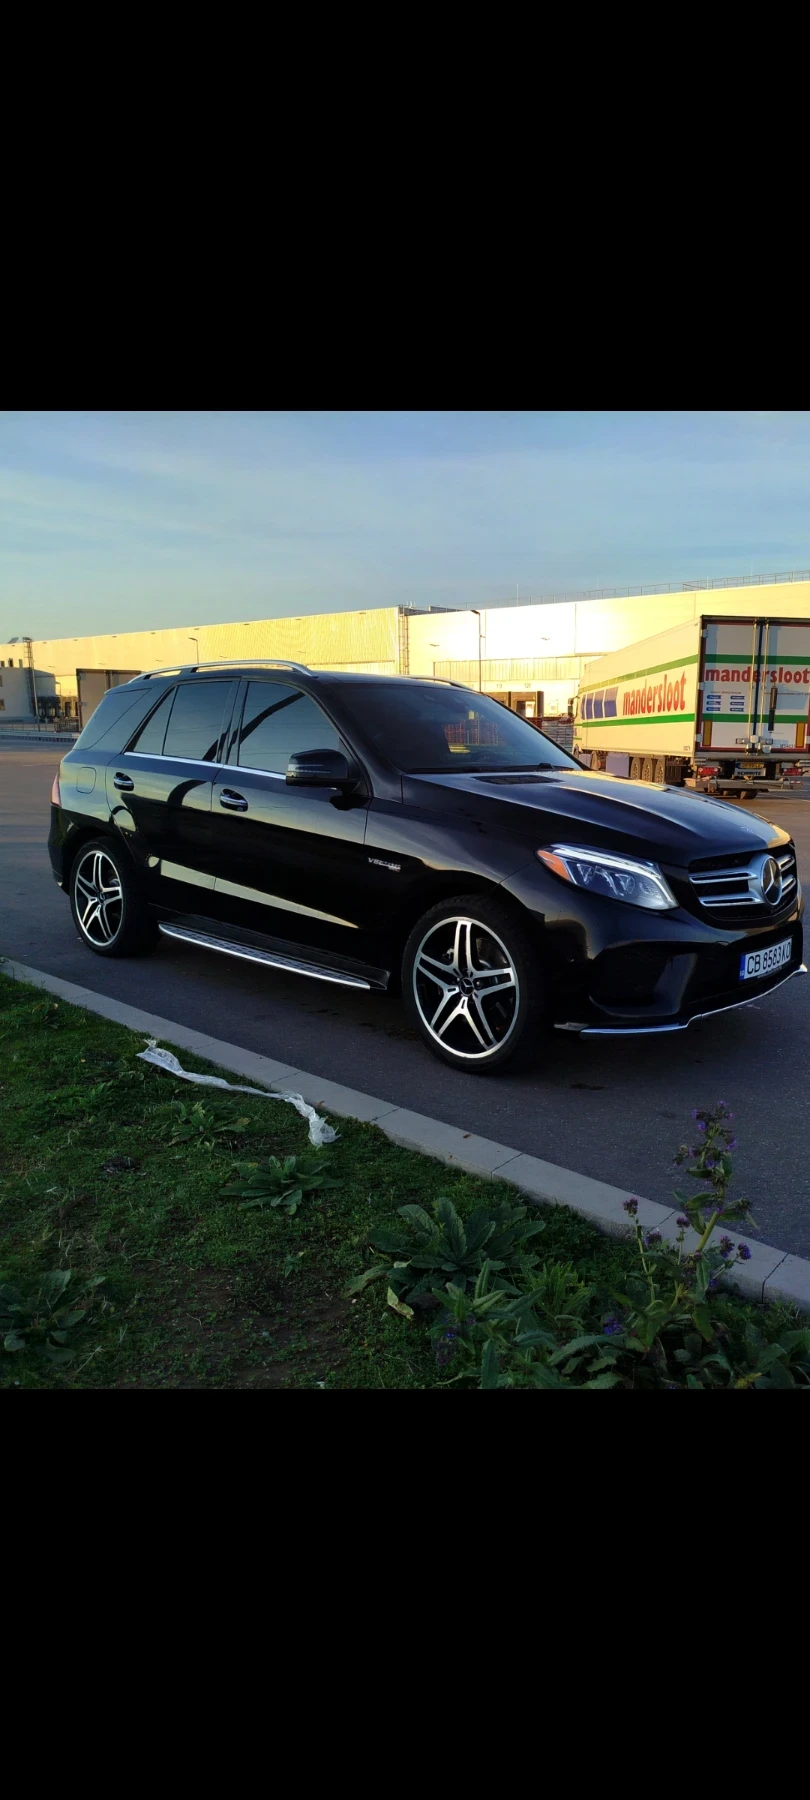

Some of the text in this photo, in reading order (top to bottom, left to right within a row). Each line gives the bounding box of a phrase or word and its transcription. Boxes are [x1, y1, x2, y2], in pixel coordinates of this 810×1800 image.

[705, 666, 810, 684] mandersloot
[623, 670, 687, 716] mandersloot
[747, 954, 760, 975] CB
[763, 946, 781, 970] 8583
